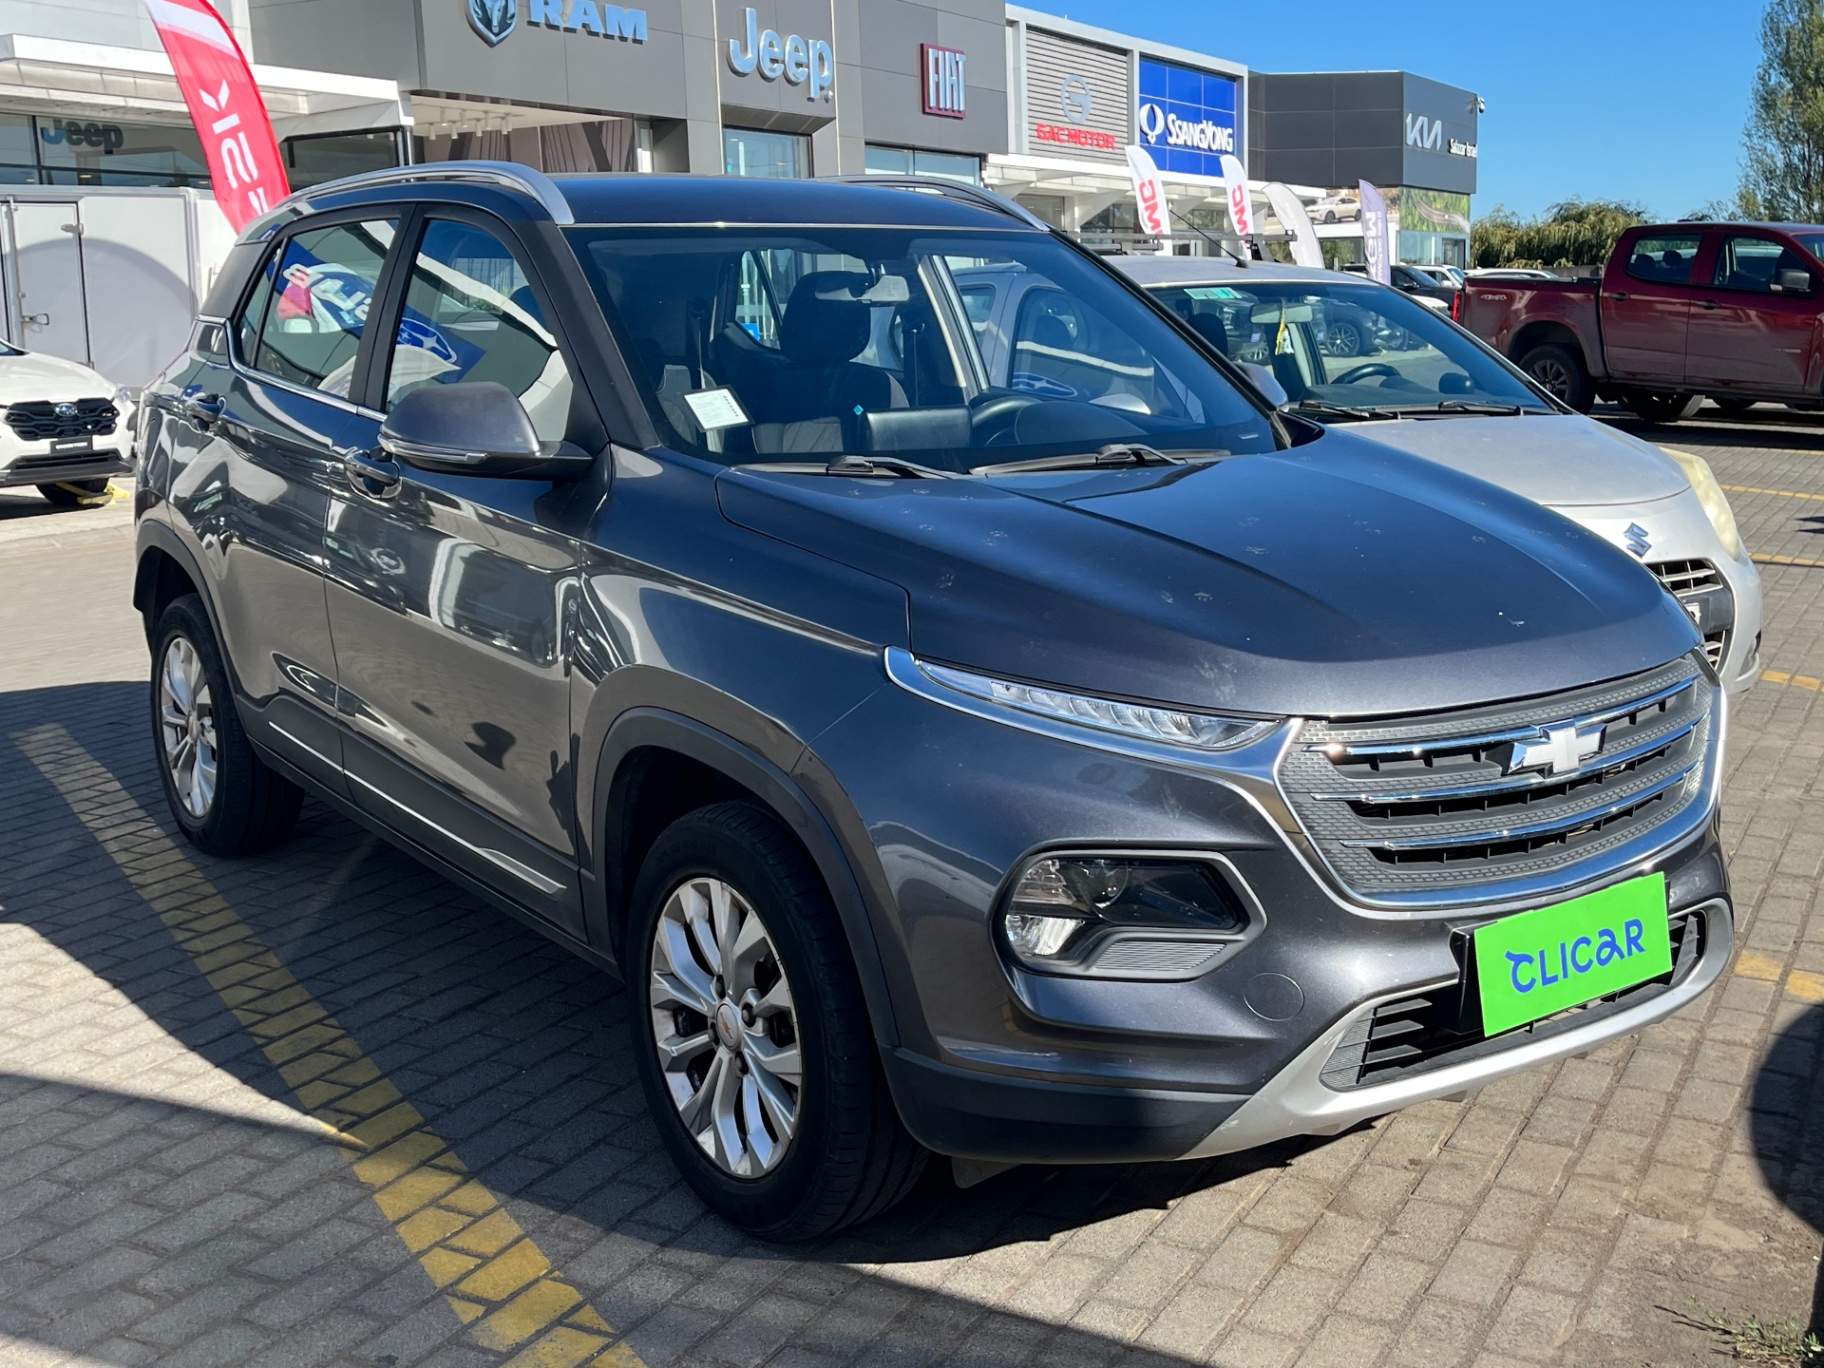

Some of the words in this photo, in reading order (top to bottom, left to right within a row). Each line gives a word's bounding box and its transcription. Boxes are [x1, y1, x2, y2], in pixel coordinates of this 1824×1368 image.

[530, 0, 647, 40] RAM
[729, 8, 831, 97] Jeep
[928, 48, 967, 111] FIAT
[40, 119, 123, 154] Jeep
[1036, 123, 1068, 143] GAC
[1069, 128, 1116, 149] MOTOR
[1406, 113, 1442, 151] KIA
